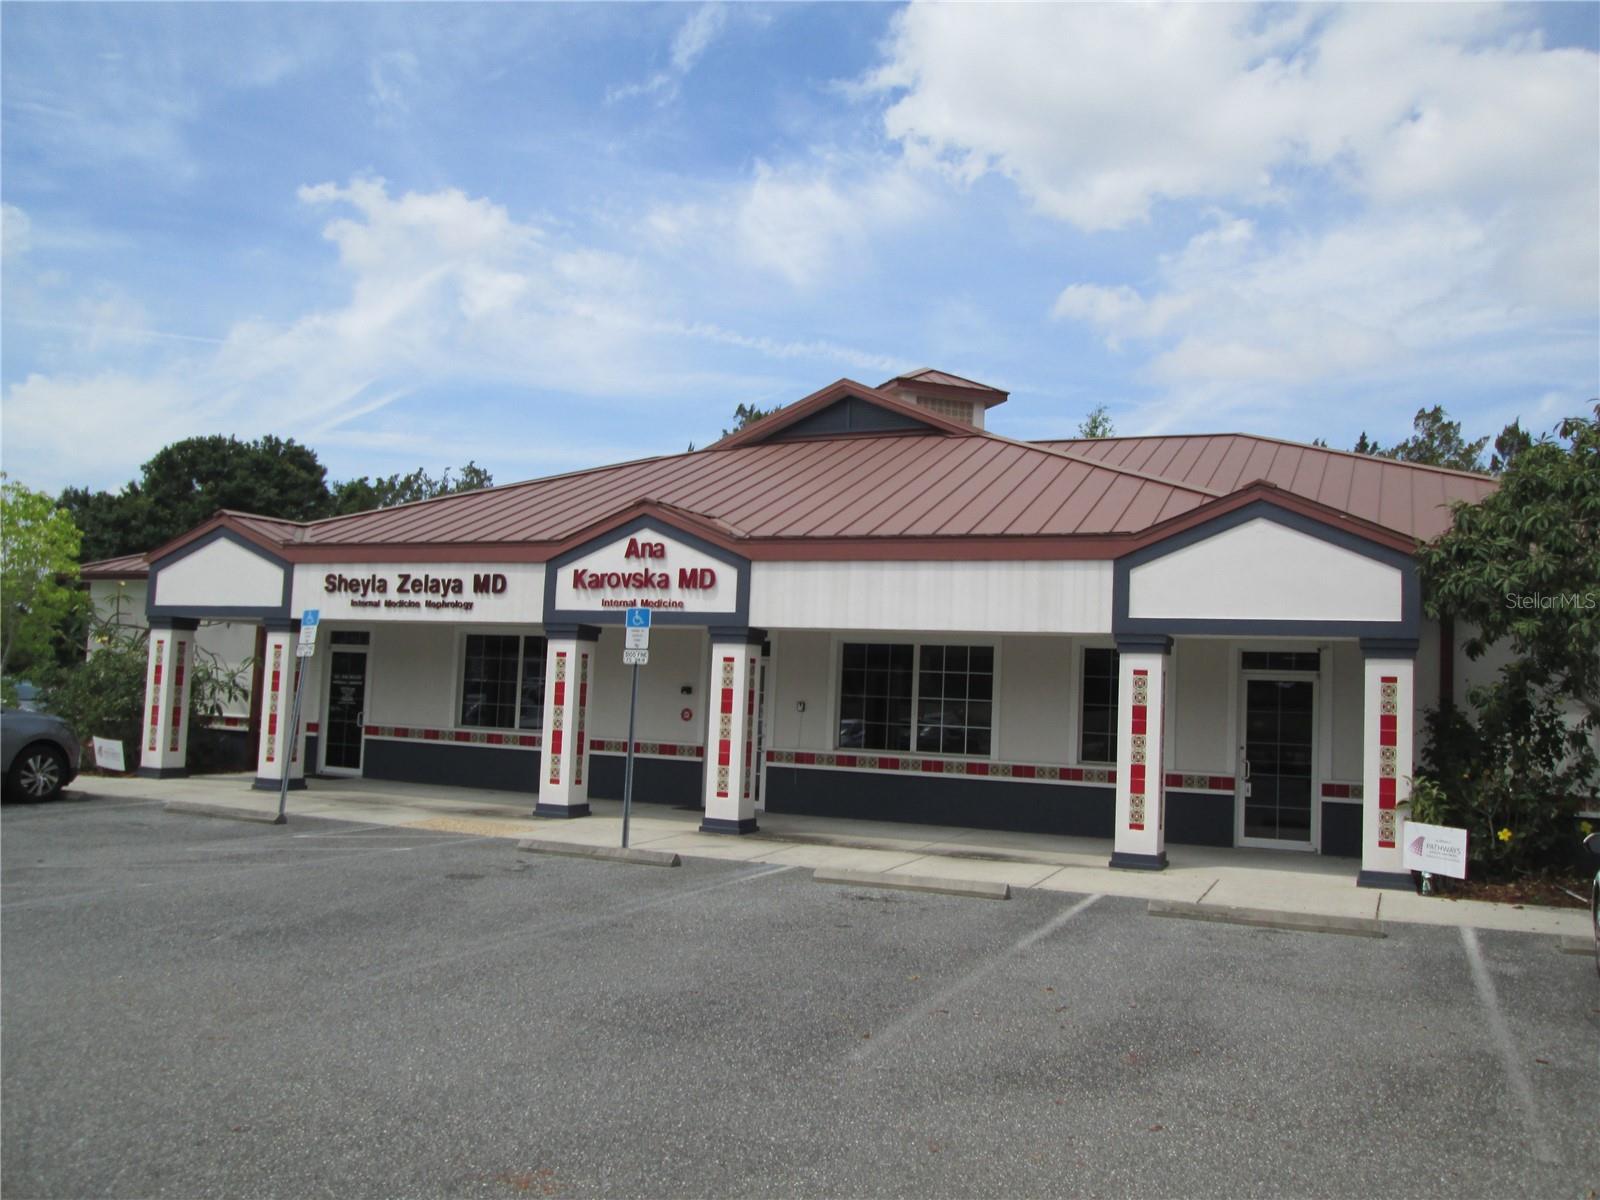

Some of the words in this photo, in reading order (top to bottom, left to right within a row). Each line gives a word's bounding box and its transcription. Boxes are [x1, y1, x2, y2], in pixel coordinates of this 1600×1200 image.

[624, 537, 665, 559] Ana
[324, 574, 388, 597] Sheyla
[396, 574, 463, 597] Zelaya
[473, 574, 507, 594] MD
[572, 568, 671, 590] Karovska
[678, 568, 717, 590] MD
[351, 600, 380, 608] Internal
[384, 600, 420, 608] Medicine
[425, 600, 474, 610] Nephrology
[601, 599, 637, 607] Internal
[640, 599, 684, 608] Medicine
[1425, 843, 1462, 855] PATHWAYS
